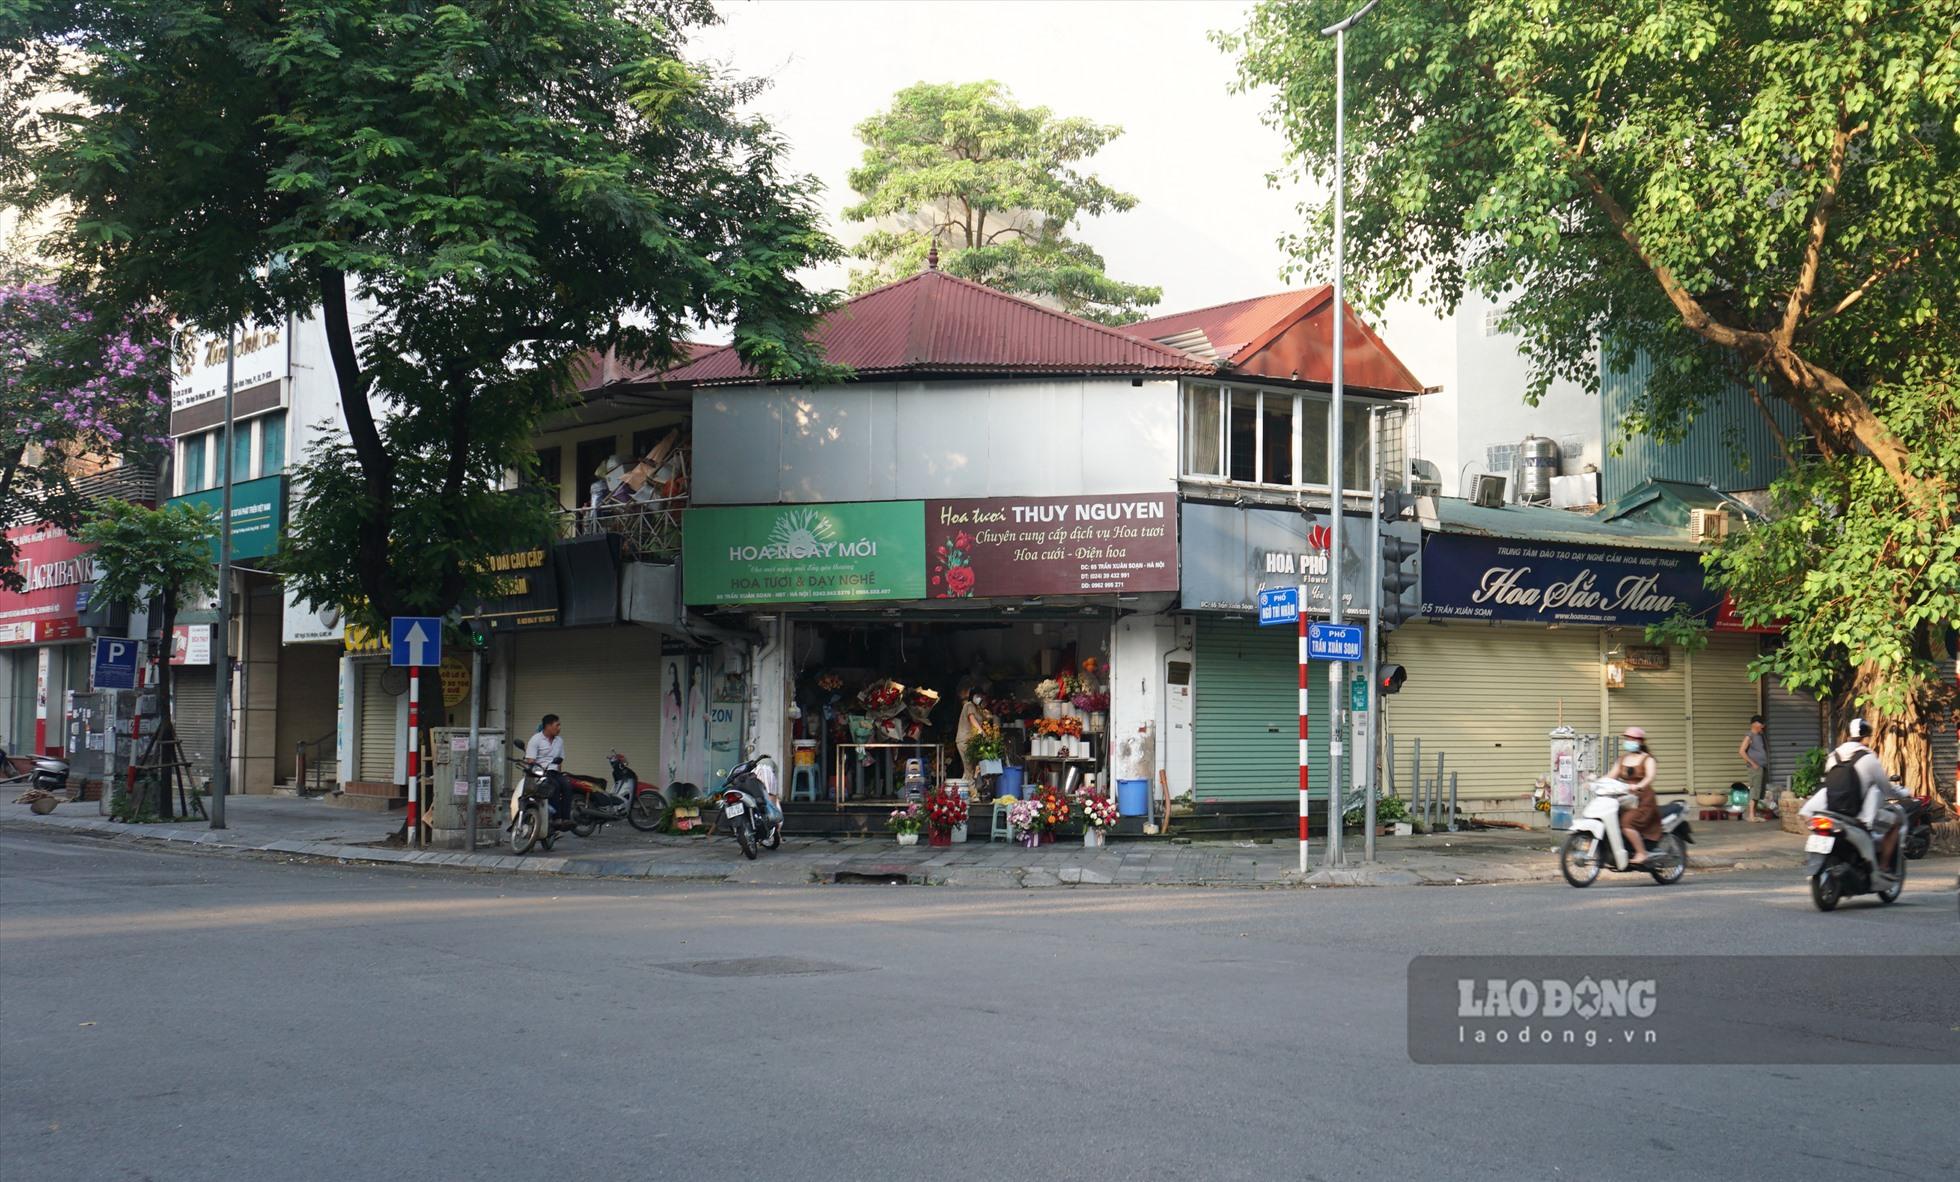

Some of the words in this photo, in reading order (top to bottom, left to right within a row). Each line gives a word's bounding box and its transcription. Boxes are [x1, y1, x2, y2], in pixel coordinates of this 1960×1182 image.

[940, 506, 969, 526] Hoa
[1012, 504, 1069, 523] THUY
[1075, 501, 1164, 521] NGUYEN
[976, 528, 1016, 546] Chuyên
[1019, 533, 1045, 545] cung
[1048, 527, 1067, 545] cấp
[1070, 526, 1094, 544] dịch
[1096, 529, 1110, 543] vụ
[1112, 526, 1138, 539] Hoa
[1141, 524, 1165, 538] tươi
[729, 545, 772, 561] HOA
[839, 537, 877, 558] MỚI
[1013, 548, 1039, 562] Hoa
[1041, 546, 1065, 560] cưới
[1074, 545, 1103, 562] Điện
[1105, 544, 1126, 559] hoa
[1497, 546, 1521, 556] TRUNG
[1522, 546, 1537, 557] TÂM
[1556, 551, 1571, 560] TẠO
[1623, 555, 1638, 564] HOA
[1266, 552, 1295, 574] HOA
[30, 556, 93, 590] AGRIBANK
[731, 577, 760, 589] HOA
[764, 575, 792, 589] TƯƠI
[796, 576, 805, 588] &
[1303, 575, 1328, 584] Flower
[1472, 566, 1541, 605] Hoa
[1539, 568, 1600, 614] Sắc
[1600, 573, 1676, 612] Màu
[1421, 602, 1433, 613] 65
[1454, 605, 1474, 615] XUÂN
[1474, 607, 1493, 618] SOẠN
[1554, 612, 1617, 622] www.hoasacmau.com
[1328, 628, 1346, 638] PHỐ
[108, 642, 125, 663] P
[1328, 639, 1342, 654] XUÂN
[1344, 641, 1359, 658] SOẠN
